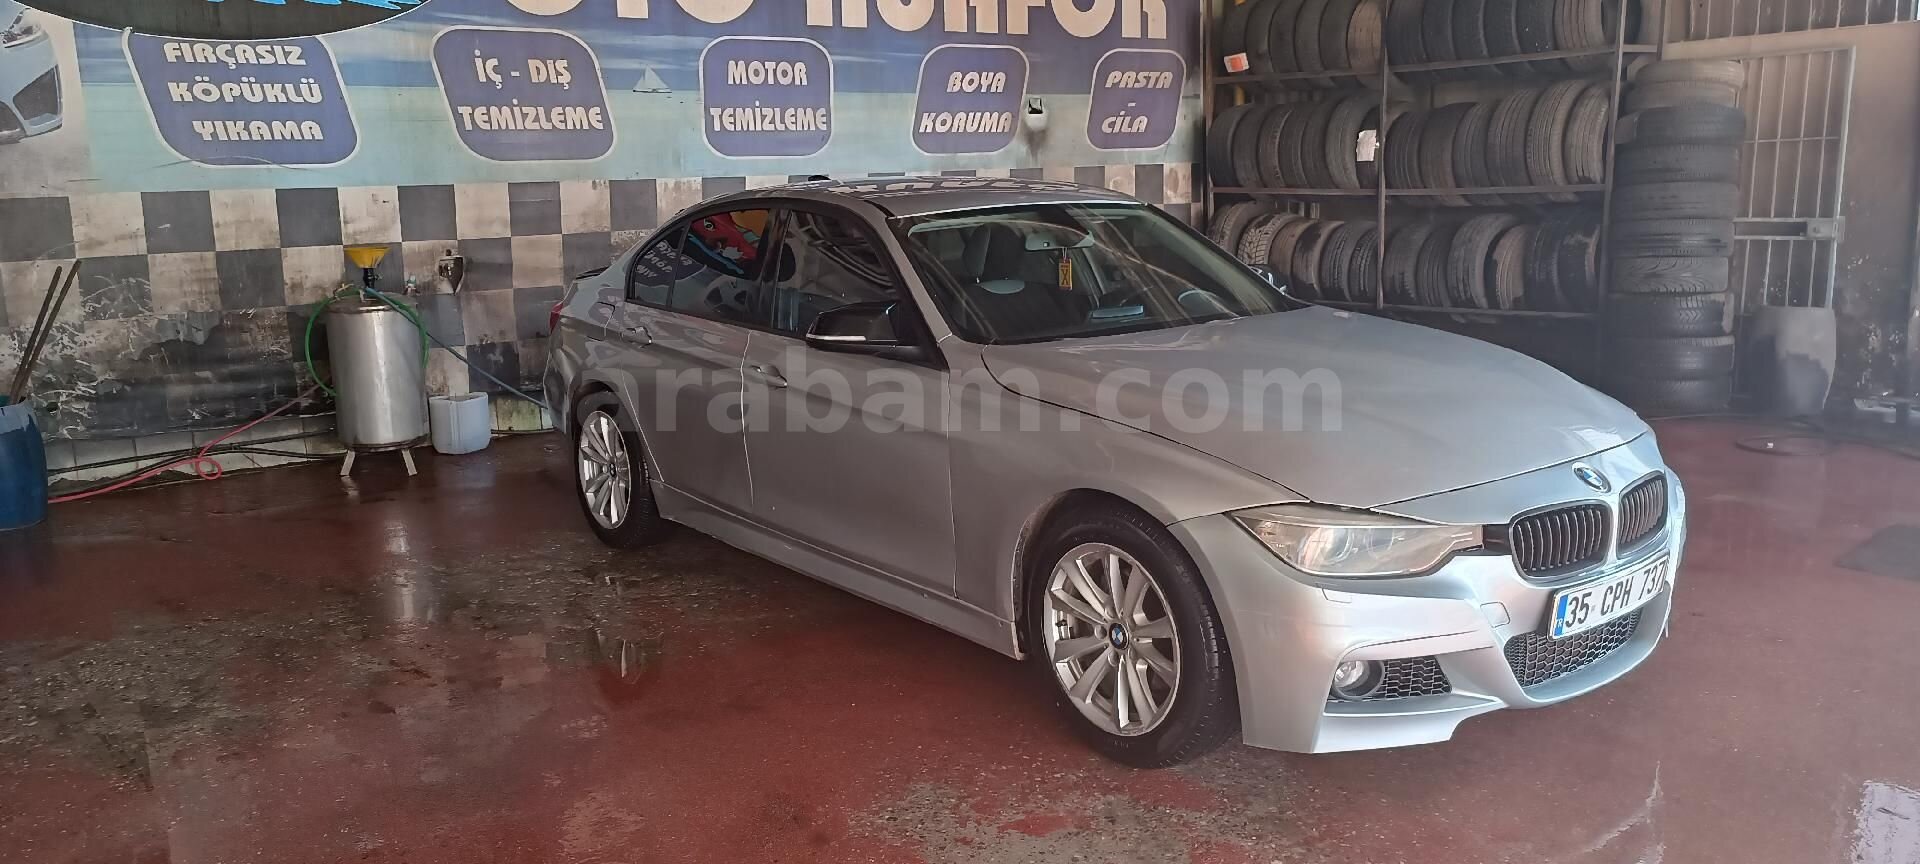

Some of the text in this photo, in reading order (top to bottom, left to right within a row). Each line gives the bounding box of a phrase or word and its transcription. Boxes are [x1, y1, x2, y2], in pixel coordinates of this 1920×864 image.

[163, 42, 307, 70] FIRÇASIZ
[474, 49, 503, 90] İÇ
[527, 58, 572, 90] DIŞ
[727, 60, 808, 86] MOTOR
[946, 71, 1007, 93] BOYA
[1104, 70, 1174, 89] PASTA
[167, 75, 323, 104] KÖPÜKLÜ
[457, 98, 604, 131] TEMİZLEME
[709, 100, 828, 132] TEMİZLEME
[918, 111, 1013, 133] KORUMA
[1101, 110, 1149, 134] CİLA
[192, 120, 324, 141] YIKAMA
[1565, 591, 1592, 628] 35
[1600, 575, 1634, 617] CPH
